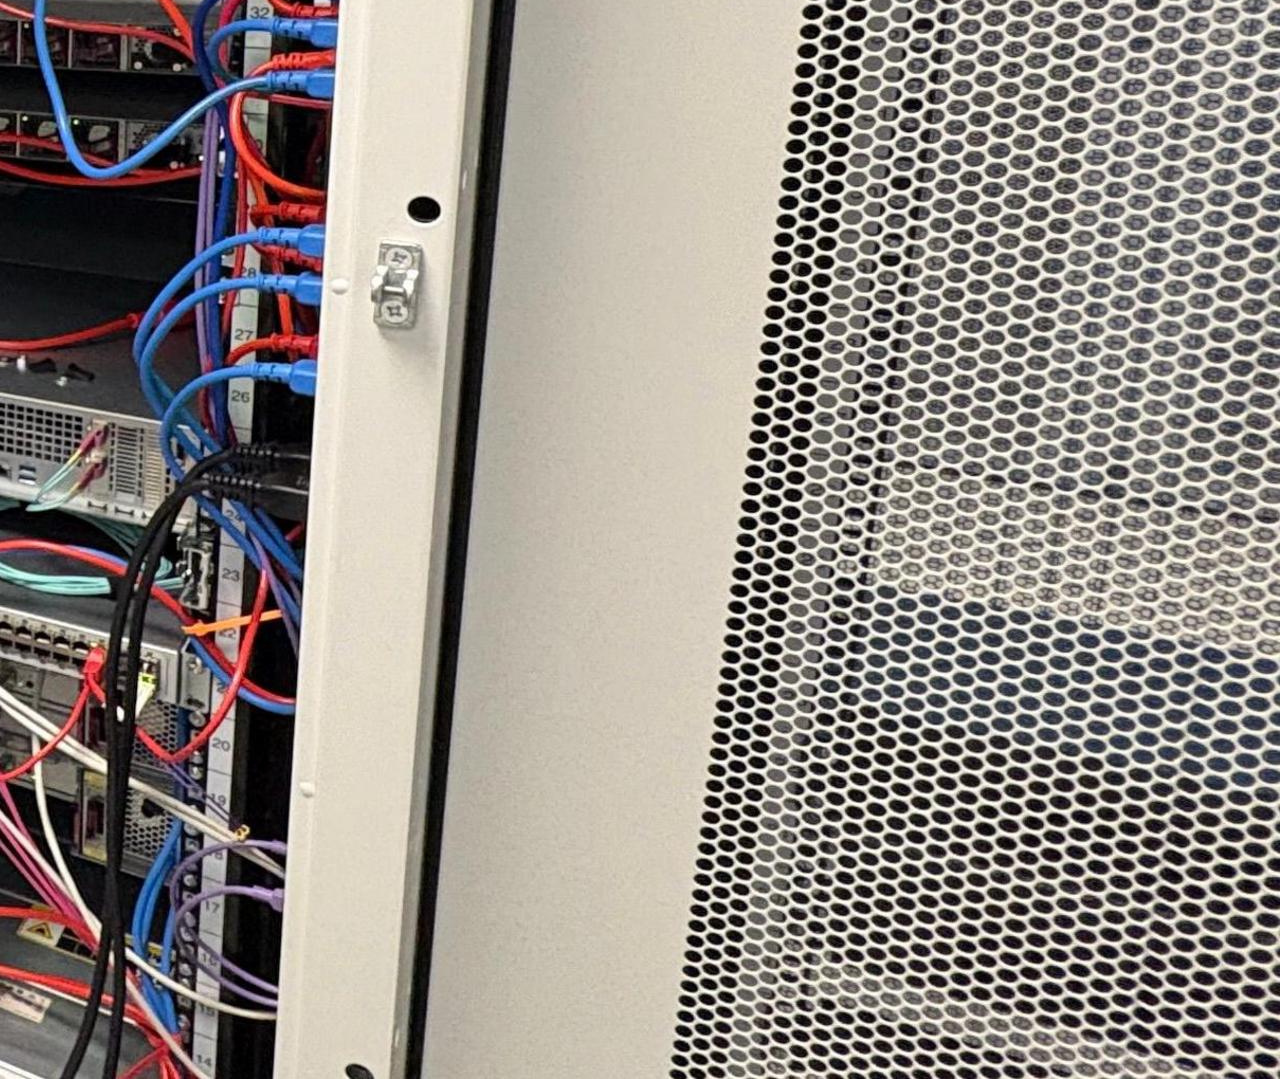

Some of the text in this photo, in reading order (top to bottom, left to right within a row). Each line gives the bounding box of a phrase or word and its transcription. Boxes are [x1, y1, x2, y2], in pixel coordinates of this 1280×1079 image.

[250, 6, 269, 19] 32
[234, 328, 254, 341] 27
[231, 389, 251, 404] 26
[221, 569, 241, 583] 23
[212, 738, 230, 752] 20
[204, 900, 220, 914] 17
